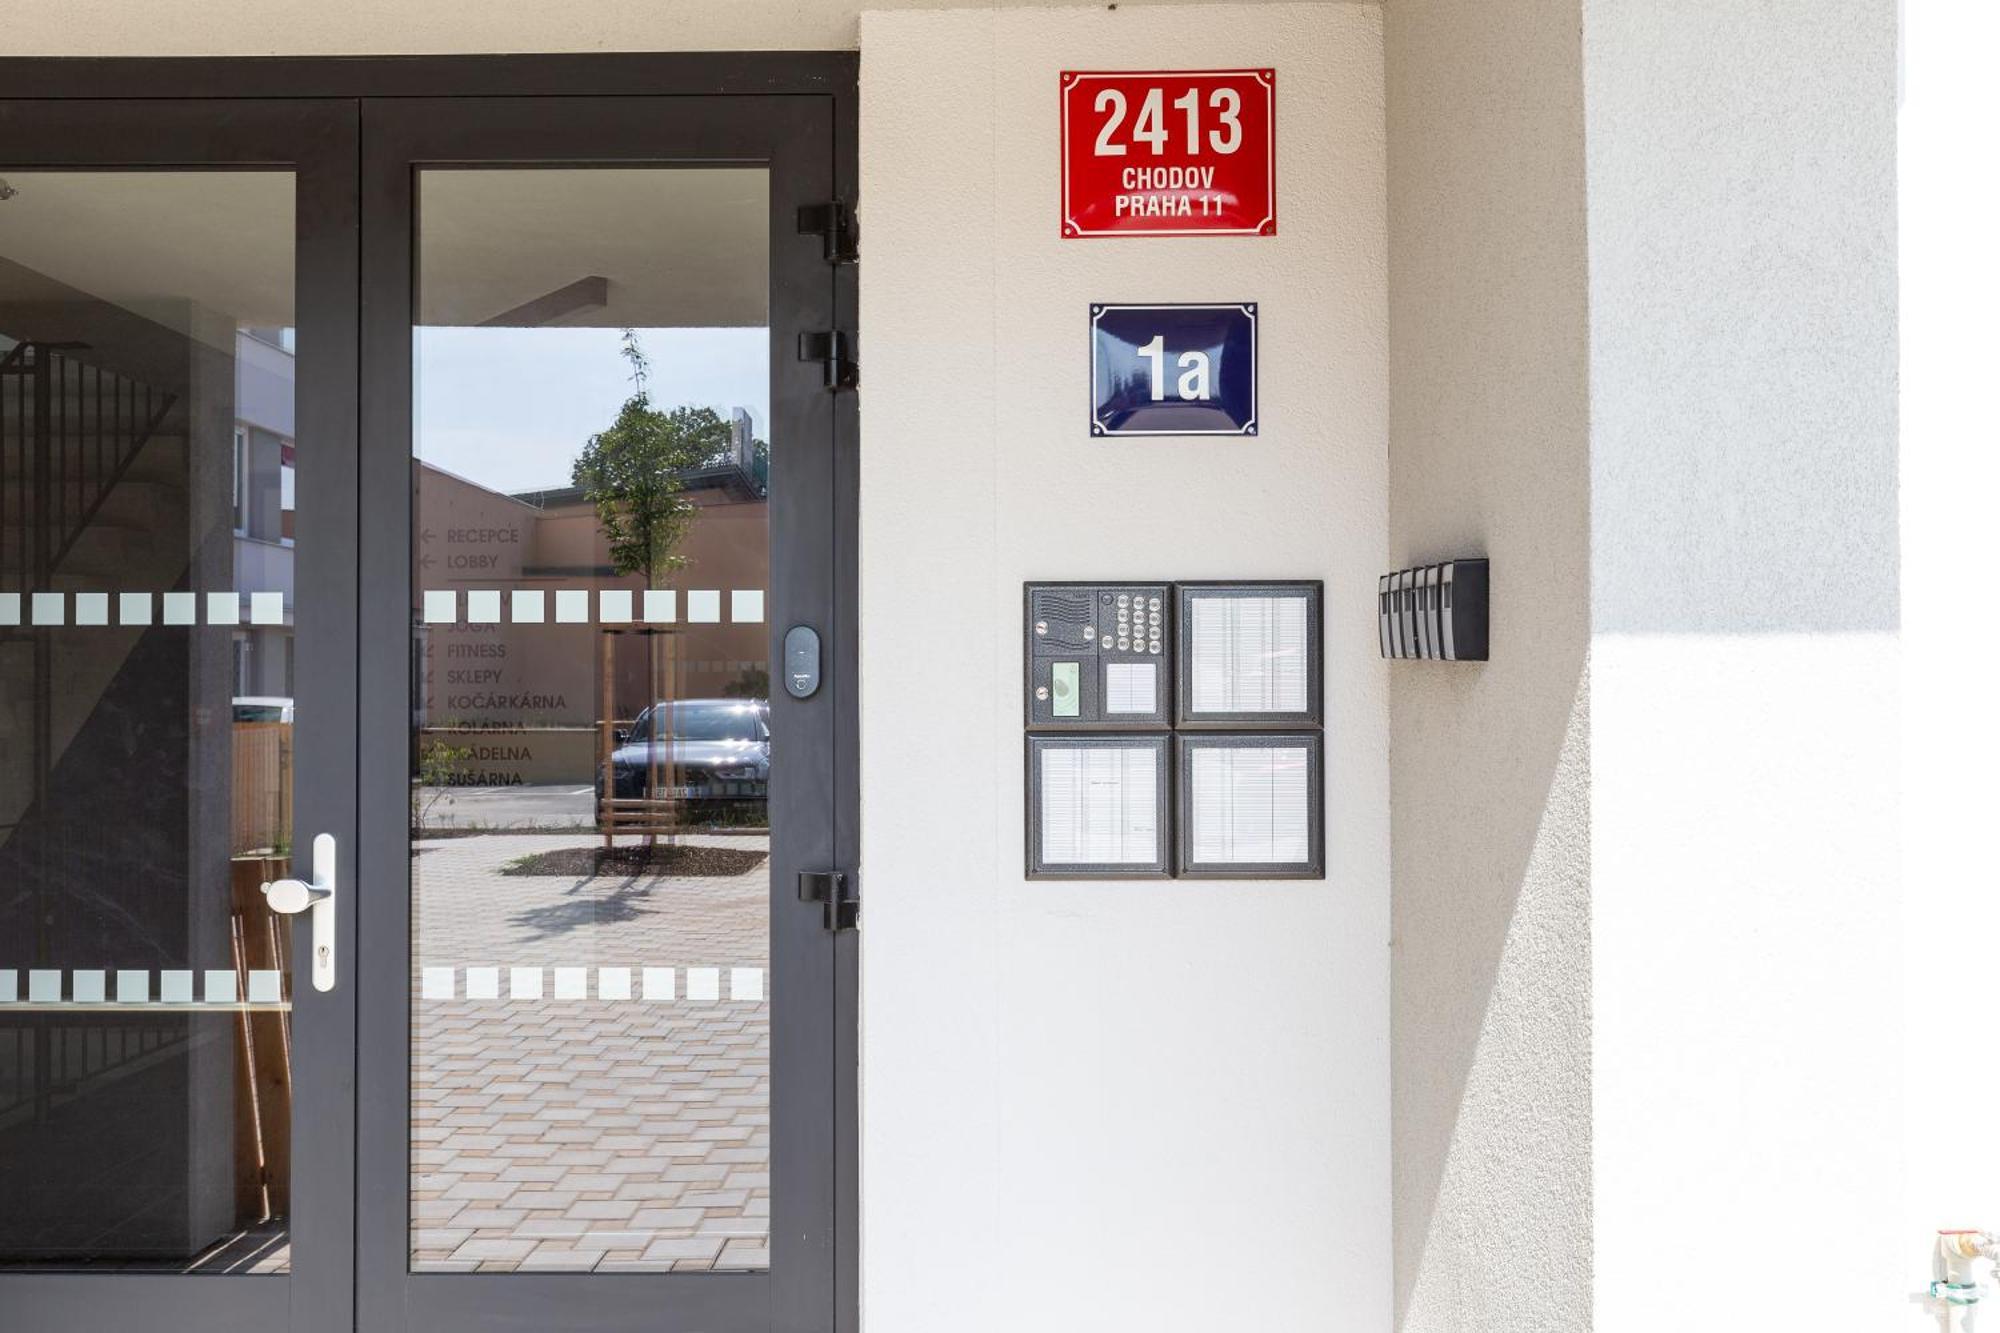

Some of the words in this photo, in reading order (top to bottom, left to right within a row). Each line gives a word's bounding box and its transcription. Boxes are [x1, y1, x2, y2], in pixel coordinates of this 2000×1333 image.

[1094, 87, 1243, 156] 2413
[1122, 166, 1215, 190] CHODOV
[1115, 195, 1193, 217] PRAHA
[1201, 195, 1223, 216] 11
[1137, 335, 1210, 401] 1a
[447, 529, 519, 544] RECEPCE
[447, 555, 499, 570] LOBBY
[447, 619, 497, 633] JOGA
[447, 644, 506, 658] FITNESS
[447, 670, 503, 684] SKLEPY
[447, 691, 566, 710] KOČÁRKÁRNA
[447, 743, 532, 761] ÁDELNA
[447, 767, 524, 787] SUŠÁRNA
